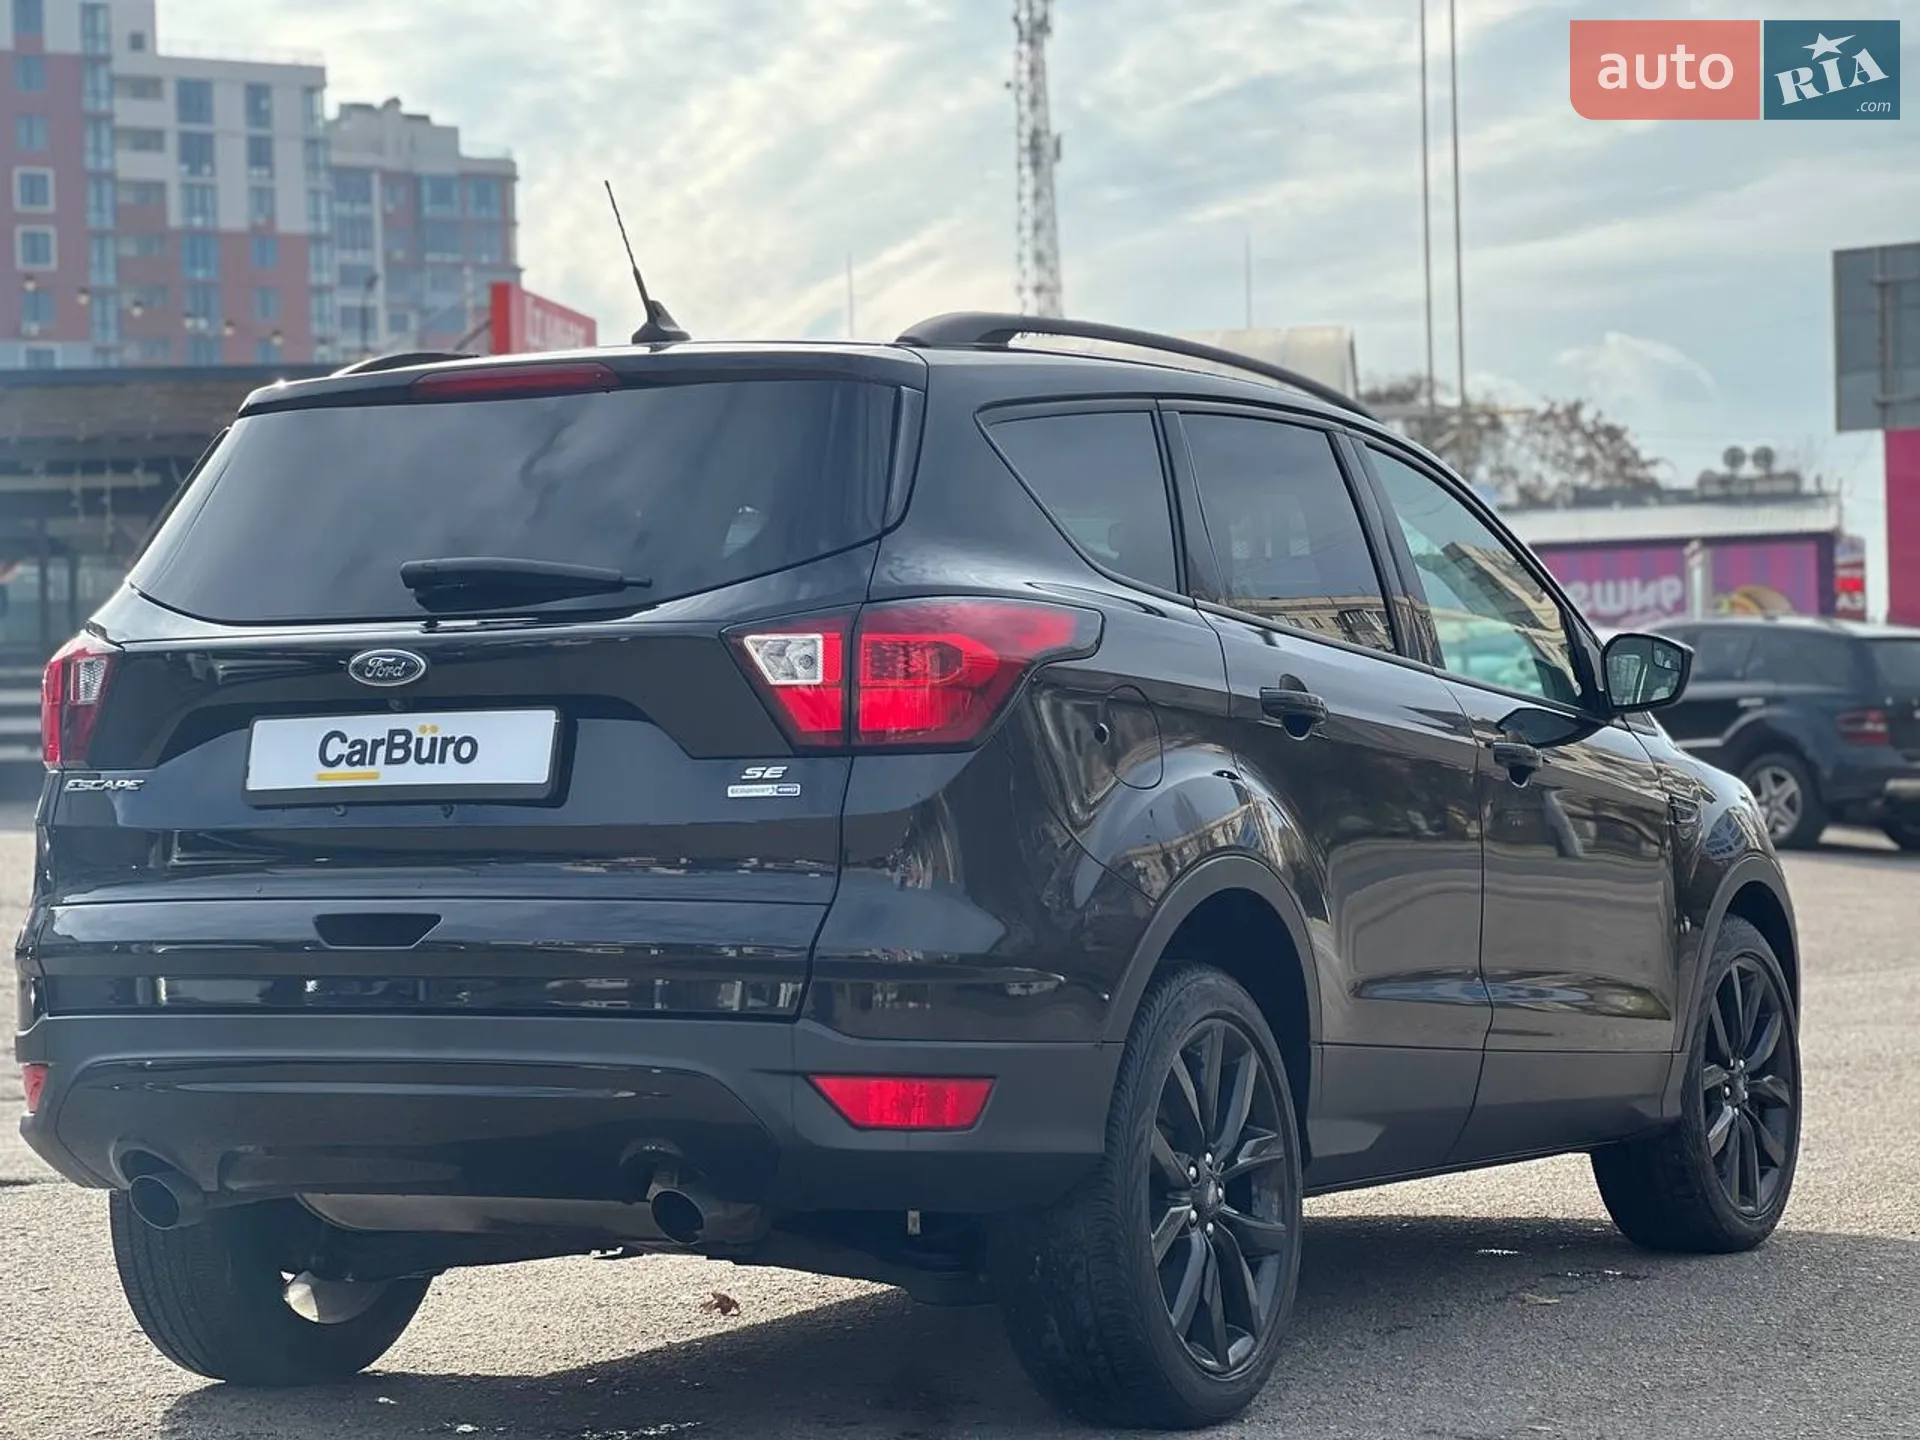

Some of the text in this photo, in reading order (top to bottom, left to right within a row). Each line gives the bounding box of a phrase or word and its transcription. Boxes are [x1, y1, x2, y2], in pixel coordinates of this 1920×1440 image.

[364, 656, 406, 678] Ford
[318, 723, 479, 768] CarBüro
[741, 766, 788, 780] SE
